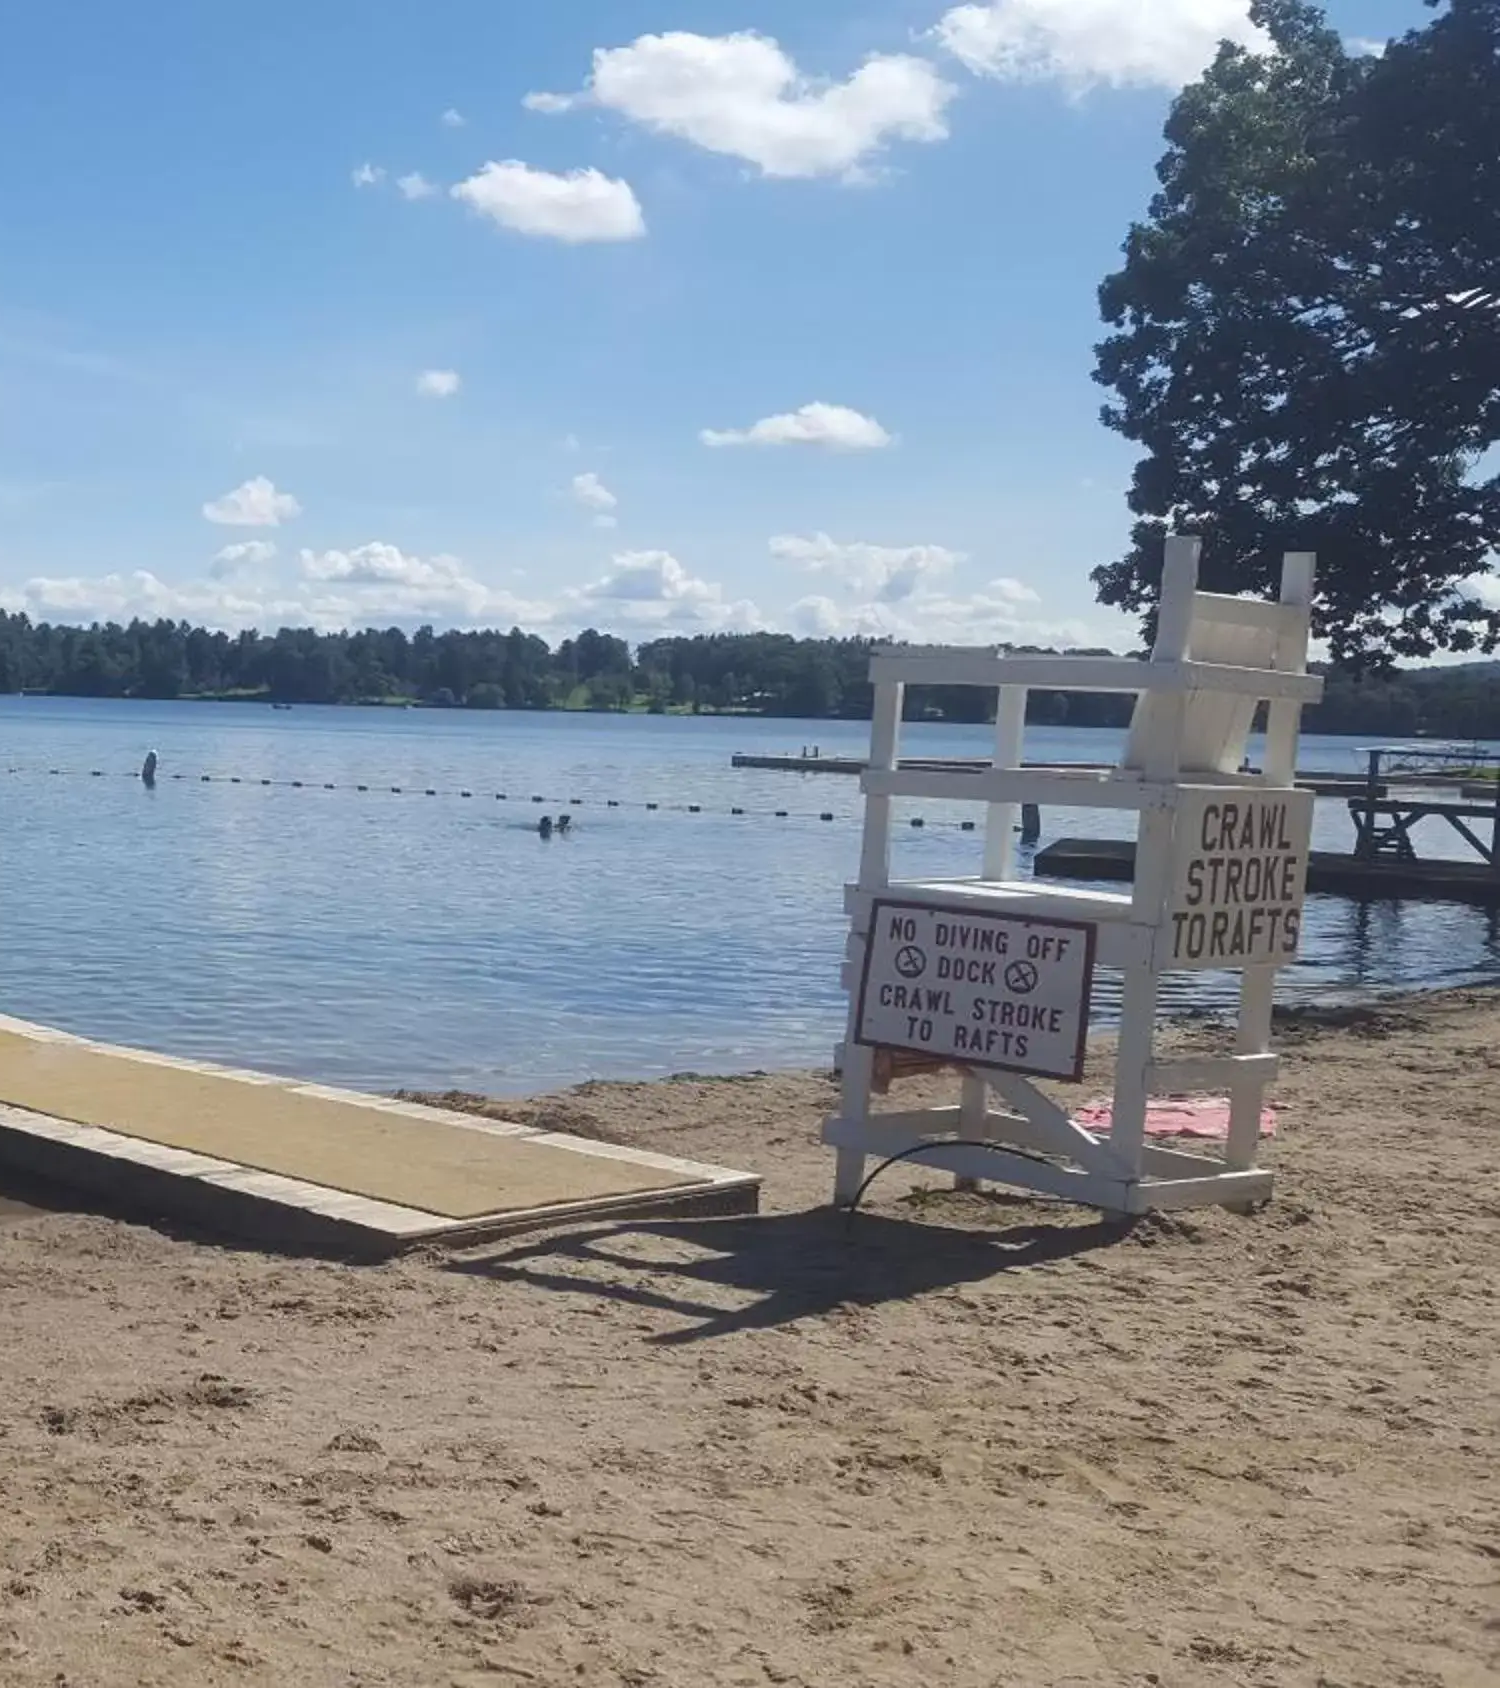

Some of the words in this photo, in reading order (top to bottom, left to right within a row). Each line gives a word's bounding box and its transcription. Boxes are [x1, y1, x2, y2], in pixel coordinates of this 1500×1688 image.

[1202, 803, 1291, 850] CRAWL
[1186, 856, 1297, 905] STROKE
[889, 916, 916, 941] NO
[935, 923, 1009, 954] DIVING
[1027, 935, 1070, 962] OFF
[937, 956, 995, 985] DOCK
[880, 984, 955, 1014] CRAWL
[972, 998, 1064, 1033] STROKE
[907, 1016, 932, 1042] TO
[954, 1025, 1029, 1057] RAFTS
